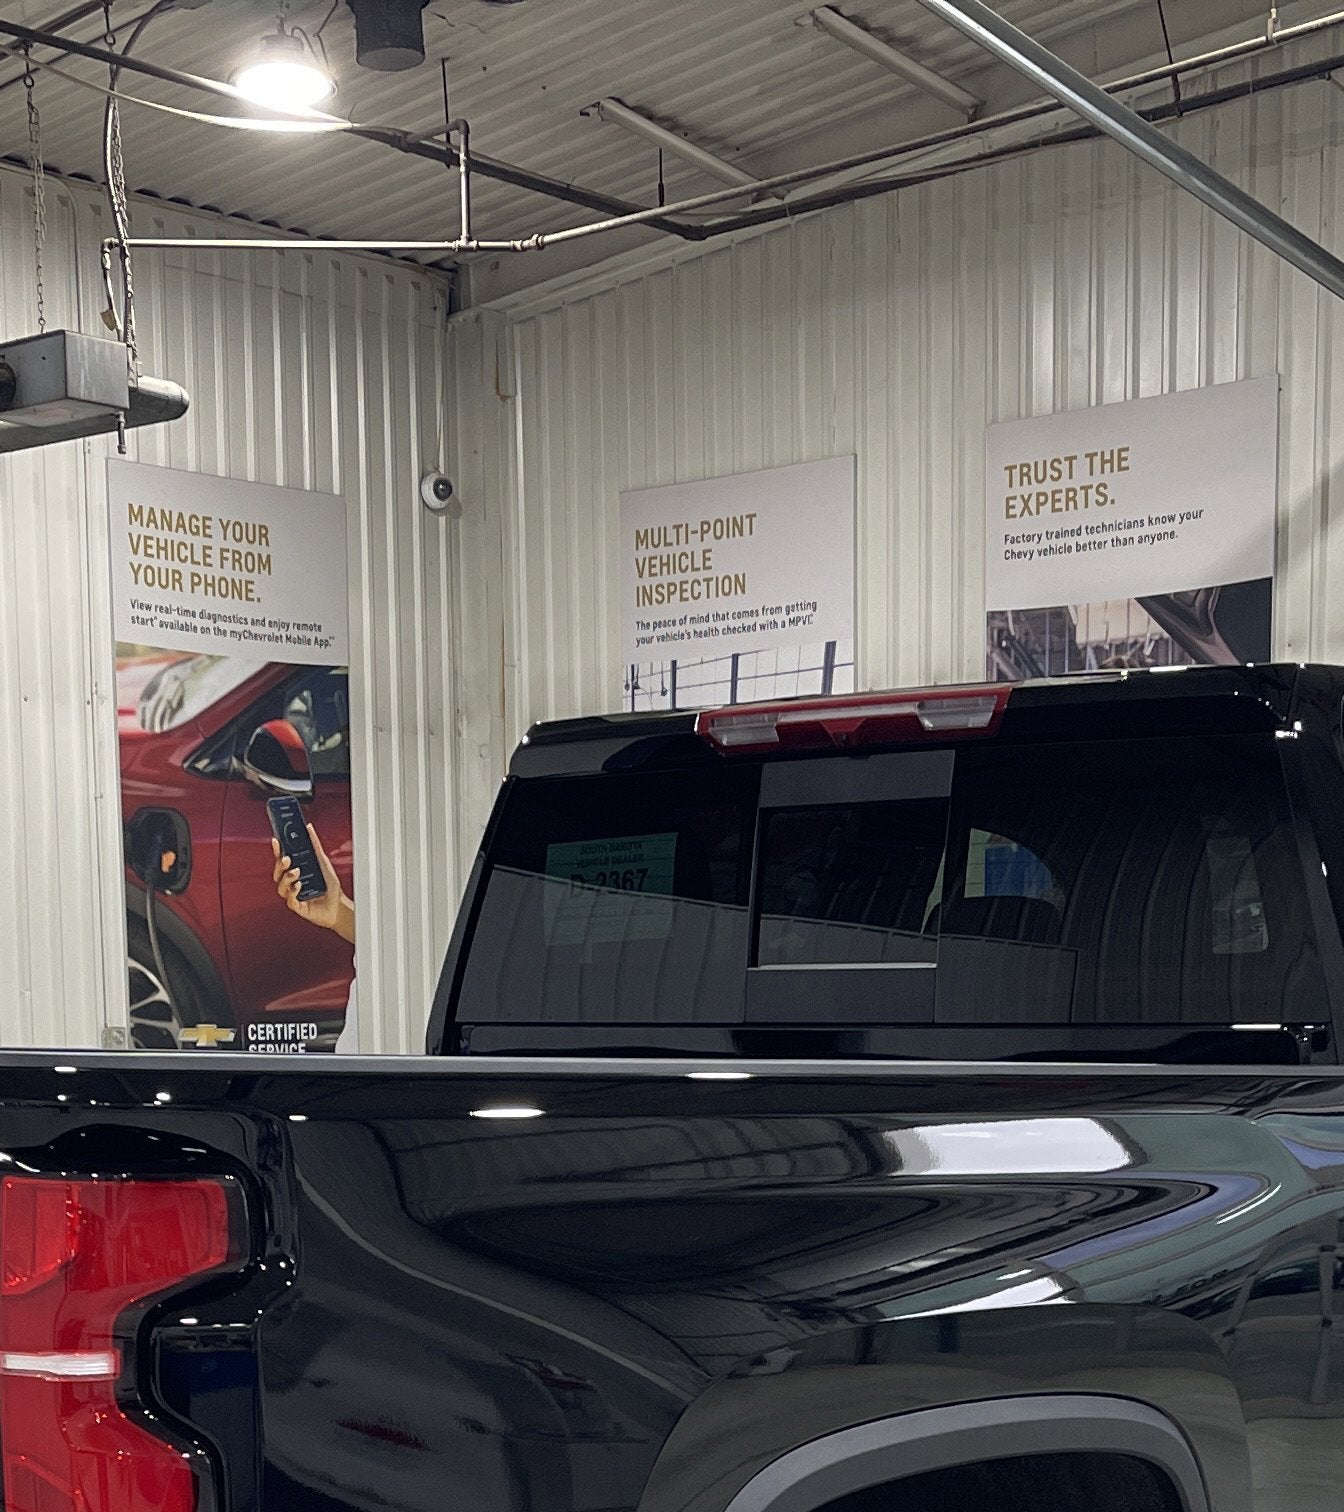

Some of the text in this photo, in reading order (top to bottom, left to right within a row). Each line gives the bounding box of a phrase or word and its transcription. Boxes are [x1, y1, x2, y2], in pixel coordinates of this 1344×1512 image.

[1004, 446, 1130, 488] TRUST THE
[1005, 482, 1116, 520] EXPERTS.
[128, 502, 270, 546] MANAGE YOUR
[635, 513, 757, 551] MULTI-POINT
[1004, 509, 1204, 545] Factory trained technicians know your
[128, 532, 272, 576] VEHICLE FROM
[1004, 529, 1179, 562] Chevy vehicle better than anyone.
[635, 548, 713, 578] VEHICLE
[128, 562, 261, 603] YOUR PHONE.
[636, 573, 746, 607] INSPECTION
[130, 599, 322, 633] View real-time diagnostics and enjoy remote
[158, 618, 198, 634] available
[200, 626, 211, 635] on
[213, 625, 228, 637] the
[229, 629, 283, 646] myChevrolet
[285, 634, 312, 646] Mobile
[636, 600, 817, 631] The peace of mind that comes from getting
[636, 635, 654, 648] your
[693, 626, 720, 639] health
[721, 623, 757, 636] checked
[759, 619, 779, 632] with
[780, 620, 786, 629] a
[248, 1023, 317, 1041] CERTIFIED
[248, 1044, 305, 1054] SERVICE
